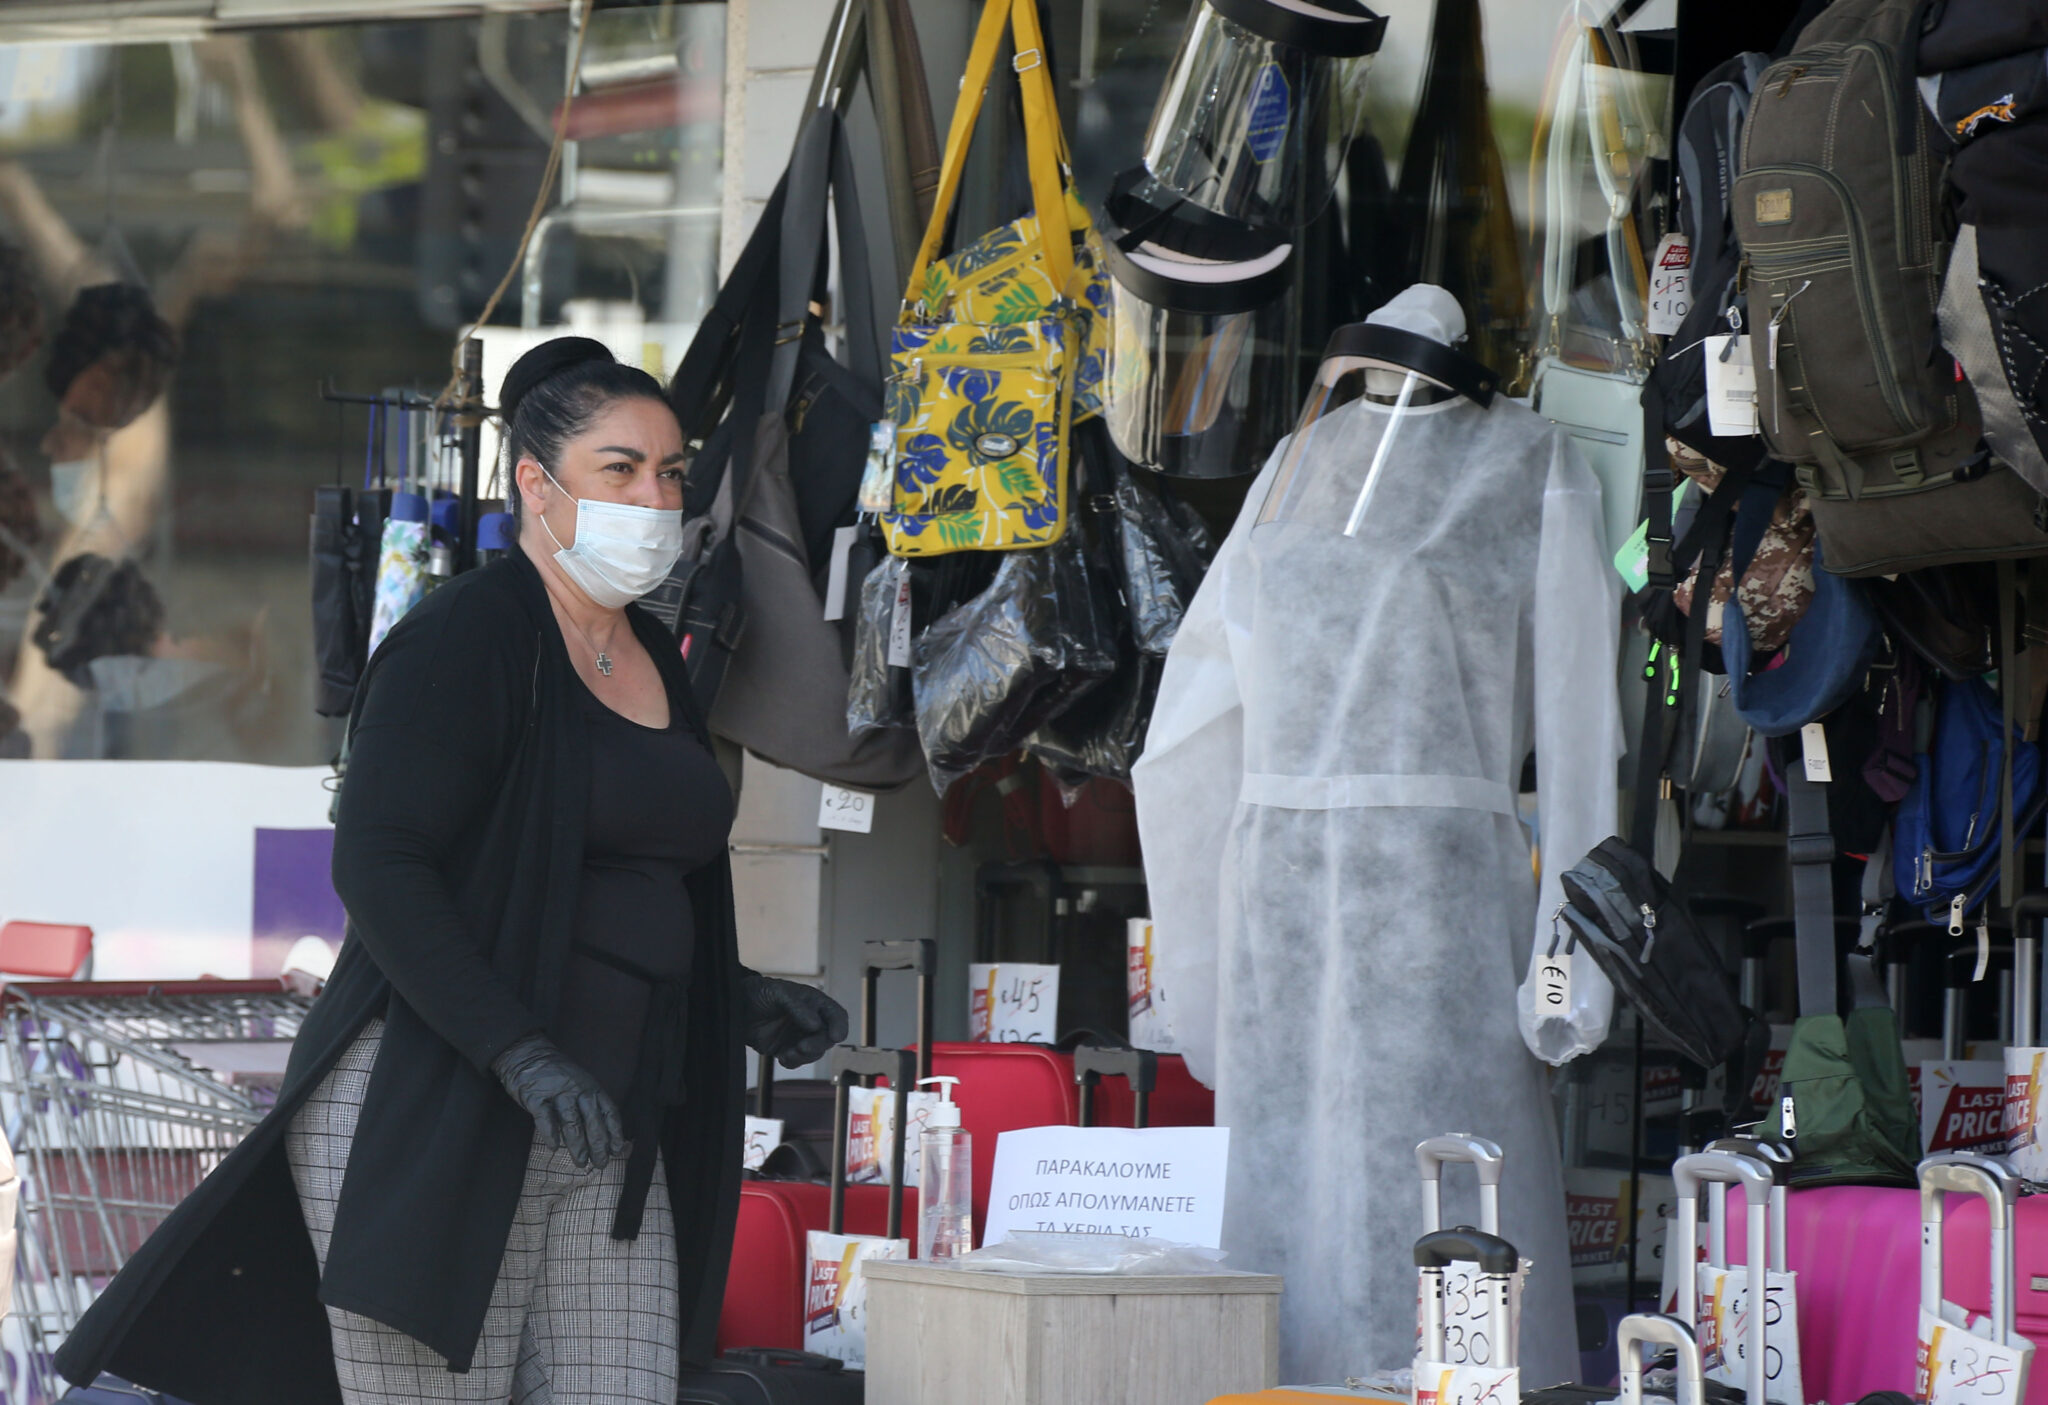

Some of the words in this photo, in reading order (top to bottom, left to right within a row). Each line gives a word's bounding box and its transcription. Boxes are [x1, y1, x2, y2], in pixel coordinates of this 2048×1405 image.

[1664, 253, 1688, 264] PRICE
[1960, 1094, 2005, 1108] LAST
[1036, 1159, 1172, 1179] ΠΑΡΑΚΑΛΟΥΜΕ
[1008, 1192, 1052, 1211] ΟΠΩΣ
[1055, 1192, 1196, 1213] ΑΠΟΛΥΜΑΝΕΤΕ
[1568, 1203, 1613, 1217] LAST
[1569, 1220, 1617, 1246] RICE
[814, 1267, 838, 1281] LAST
